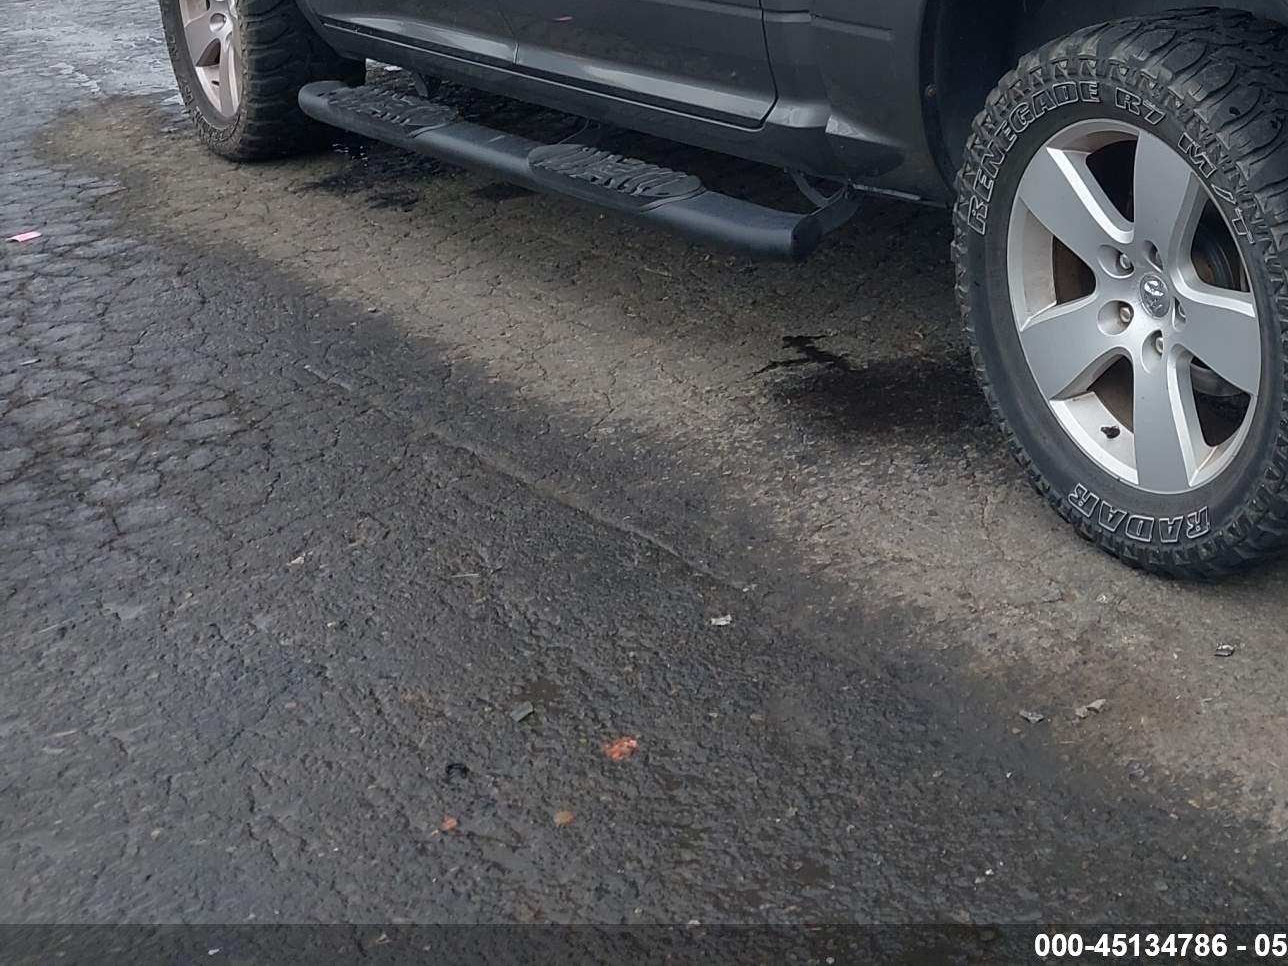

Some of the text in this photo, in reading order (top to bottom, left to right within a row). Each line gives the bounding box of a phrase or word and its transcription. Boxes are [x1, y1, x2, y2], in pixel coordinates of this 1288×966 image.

[968, 81, 1101, 234] RENEGADE
[1177, 132, 1255, 244] M/T
[1068, 482, 1211, 543] RADAR
